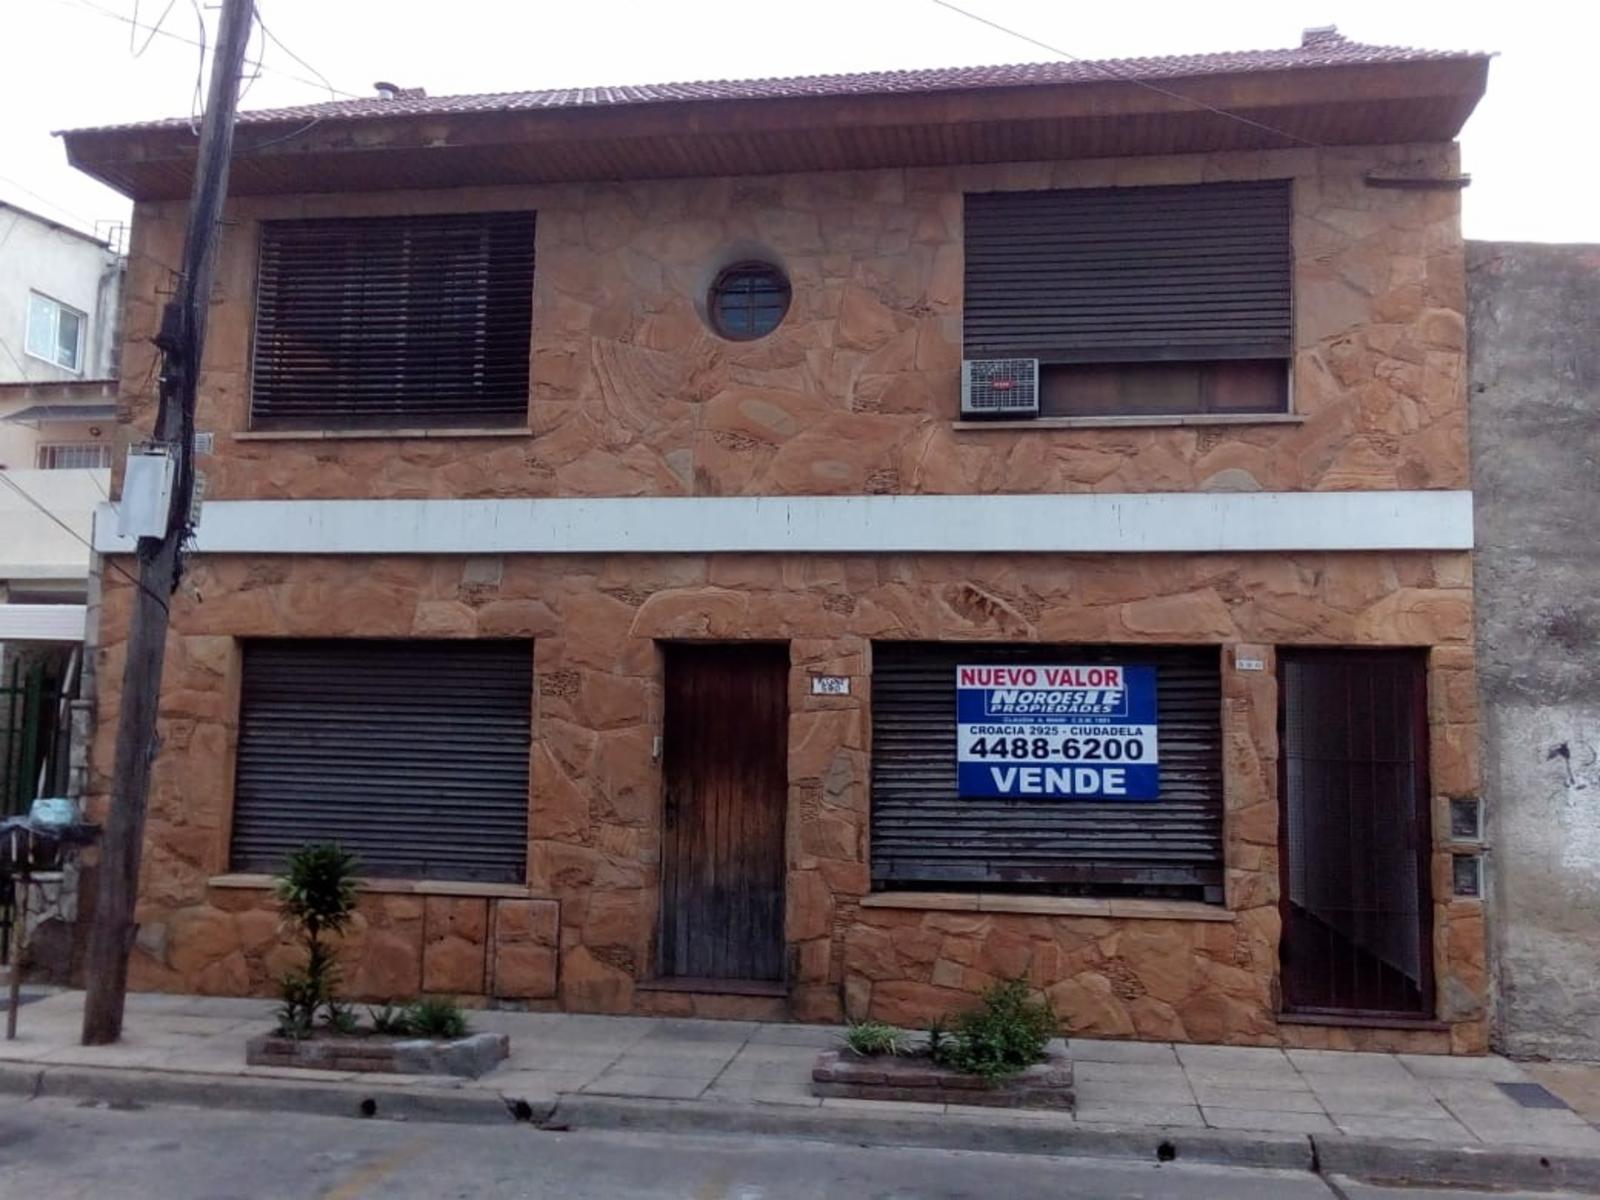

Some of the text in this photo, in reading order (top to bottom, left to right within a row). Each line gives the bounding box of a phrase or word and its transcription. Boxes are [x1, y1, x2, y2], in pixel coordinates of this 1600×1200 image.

[961, 668, 1119, 687] NUEVO VALOR
[990, 704, 1112, 713] PROPIEDADES
[970, 726, 1025, 735] CROACIA
[1070, 727, 1143, 737] CIUDADELA
[969, 737, 1144, 760] 4488-6200
[990, 767, 1126, 794] VENDE
